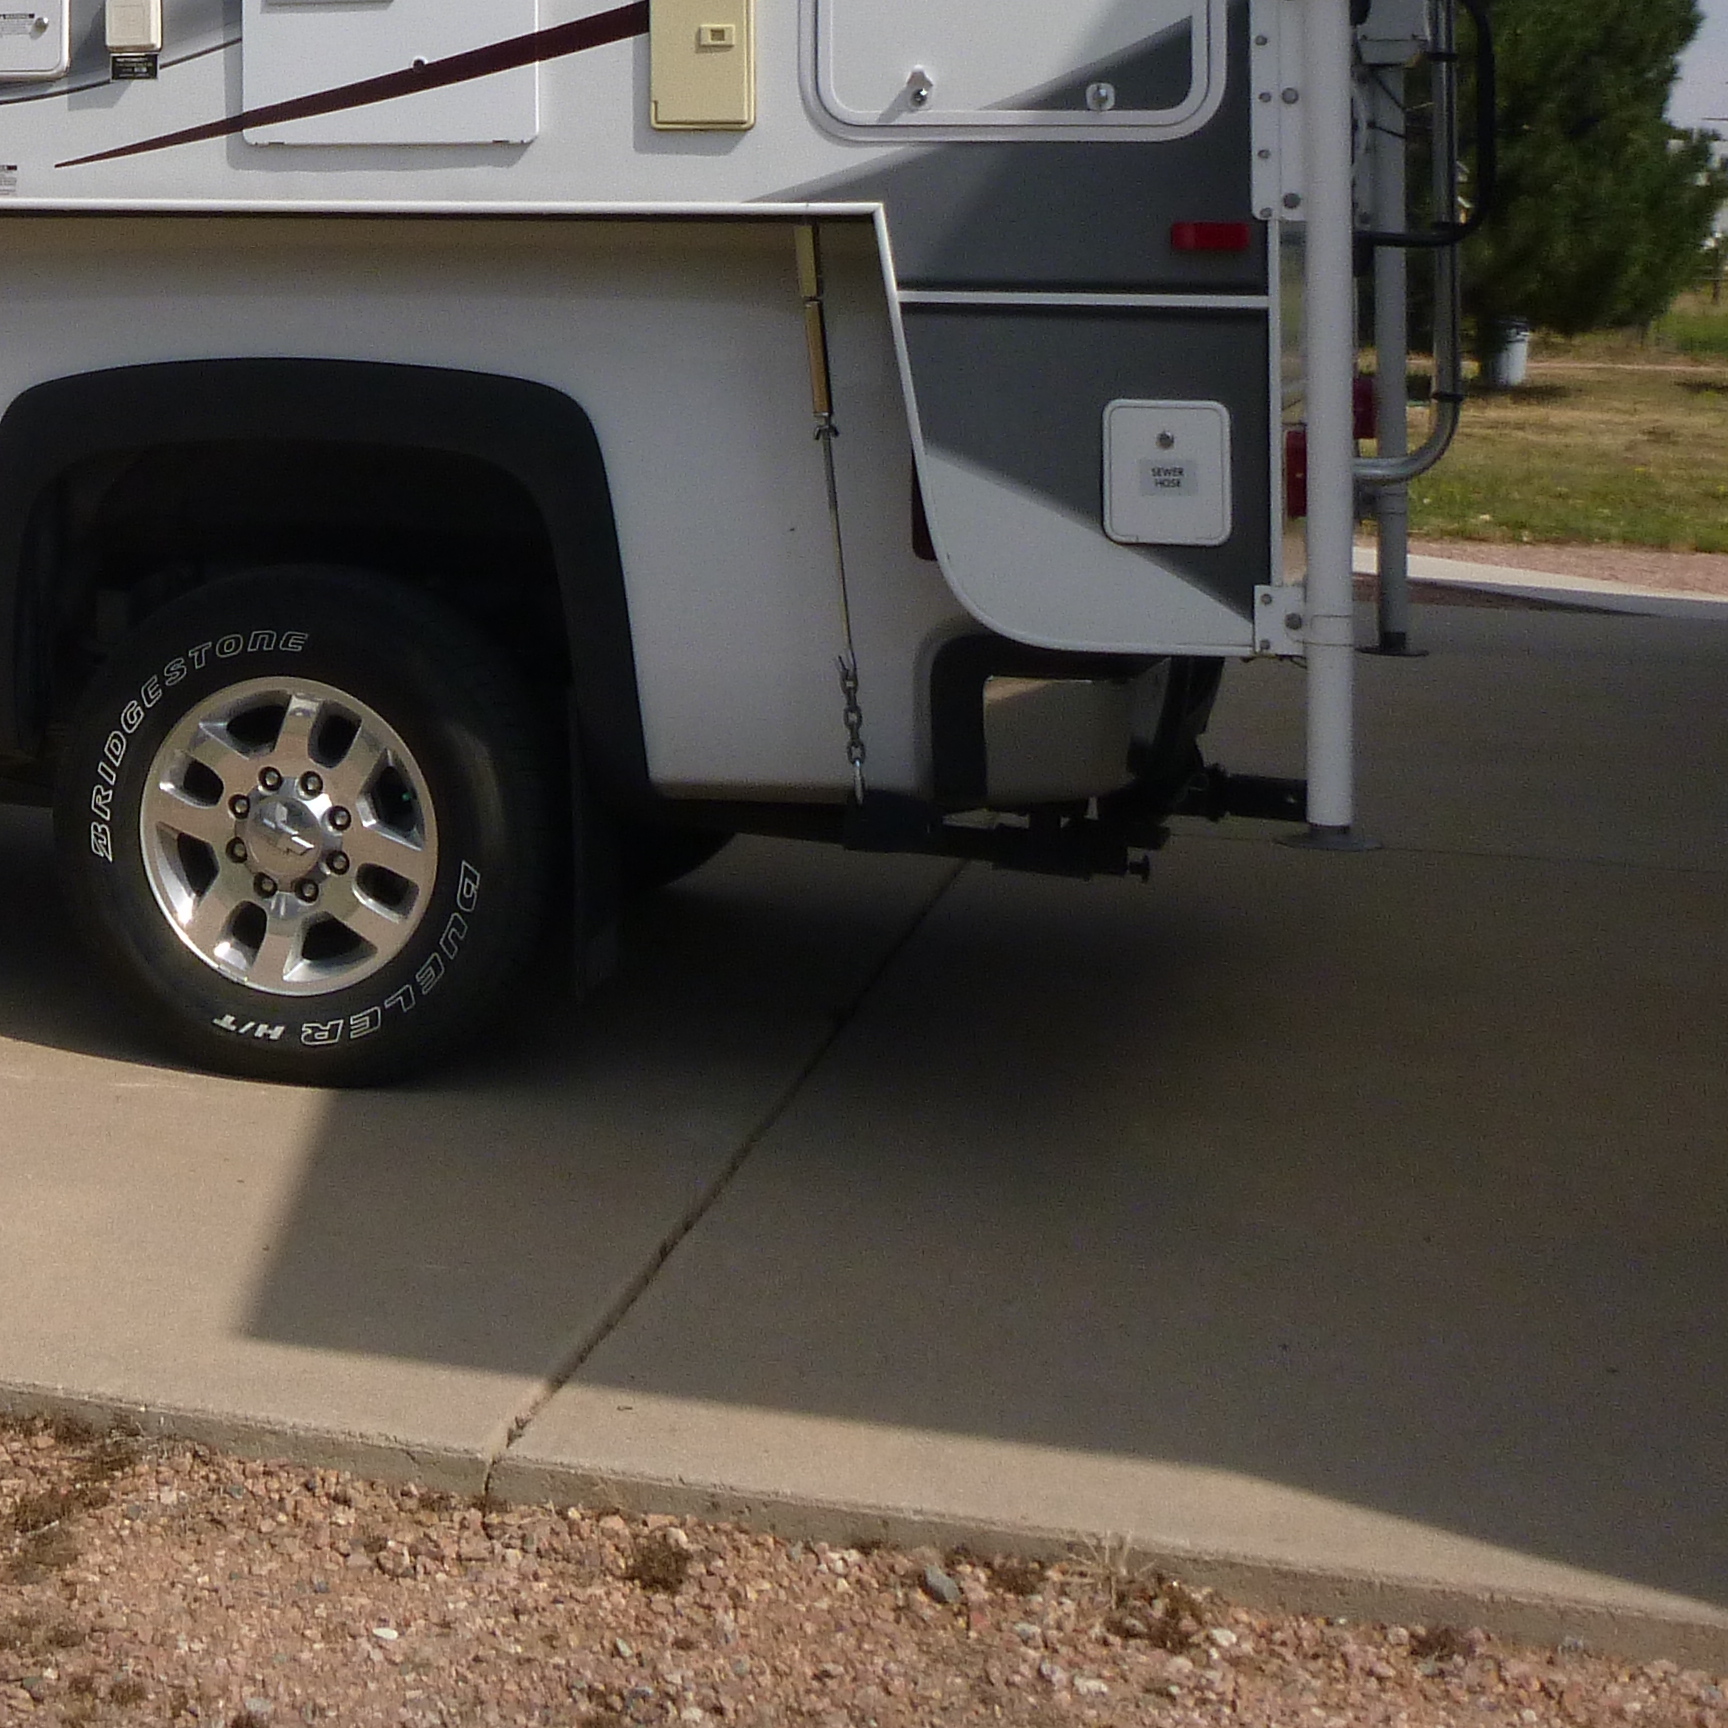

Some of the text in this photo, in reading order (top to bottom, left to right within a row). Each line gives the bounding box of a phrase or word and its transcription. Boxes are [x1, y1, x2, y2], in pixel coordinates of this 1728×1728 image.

[90, 630, 309, 862] BRIDGESTONE
[213, 860, 481, 1046] DUELER H/T
